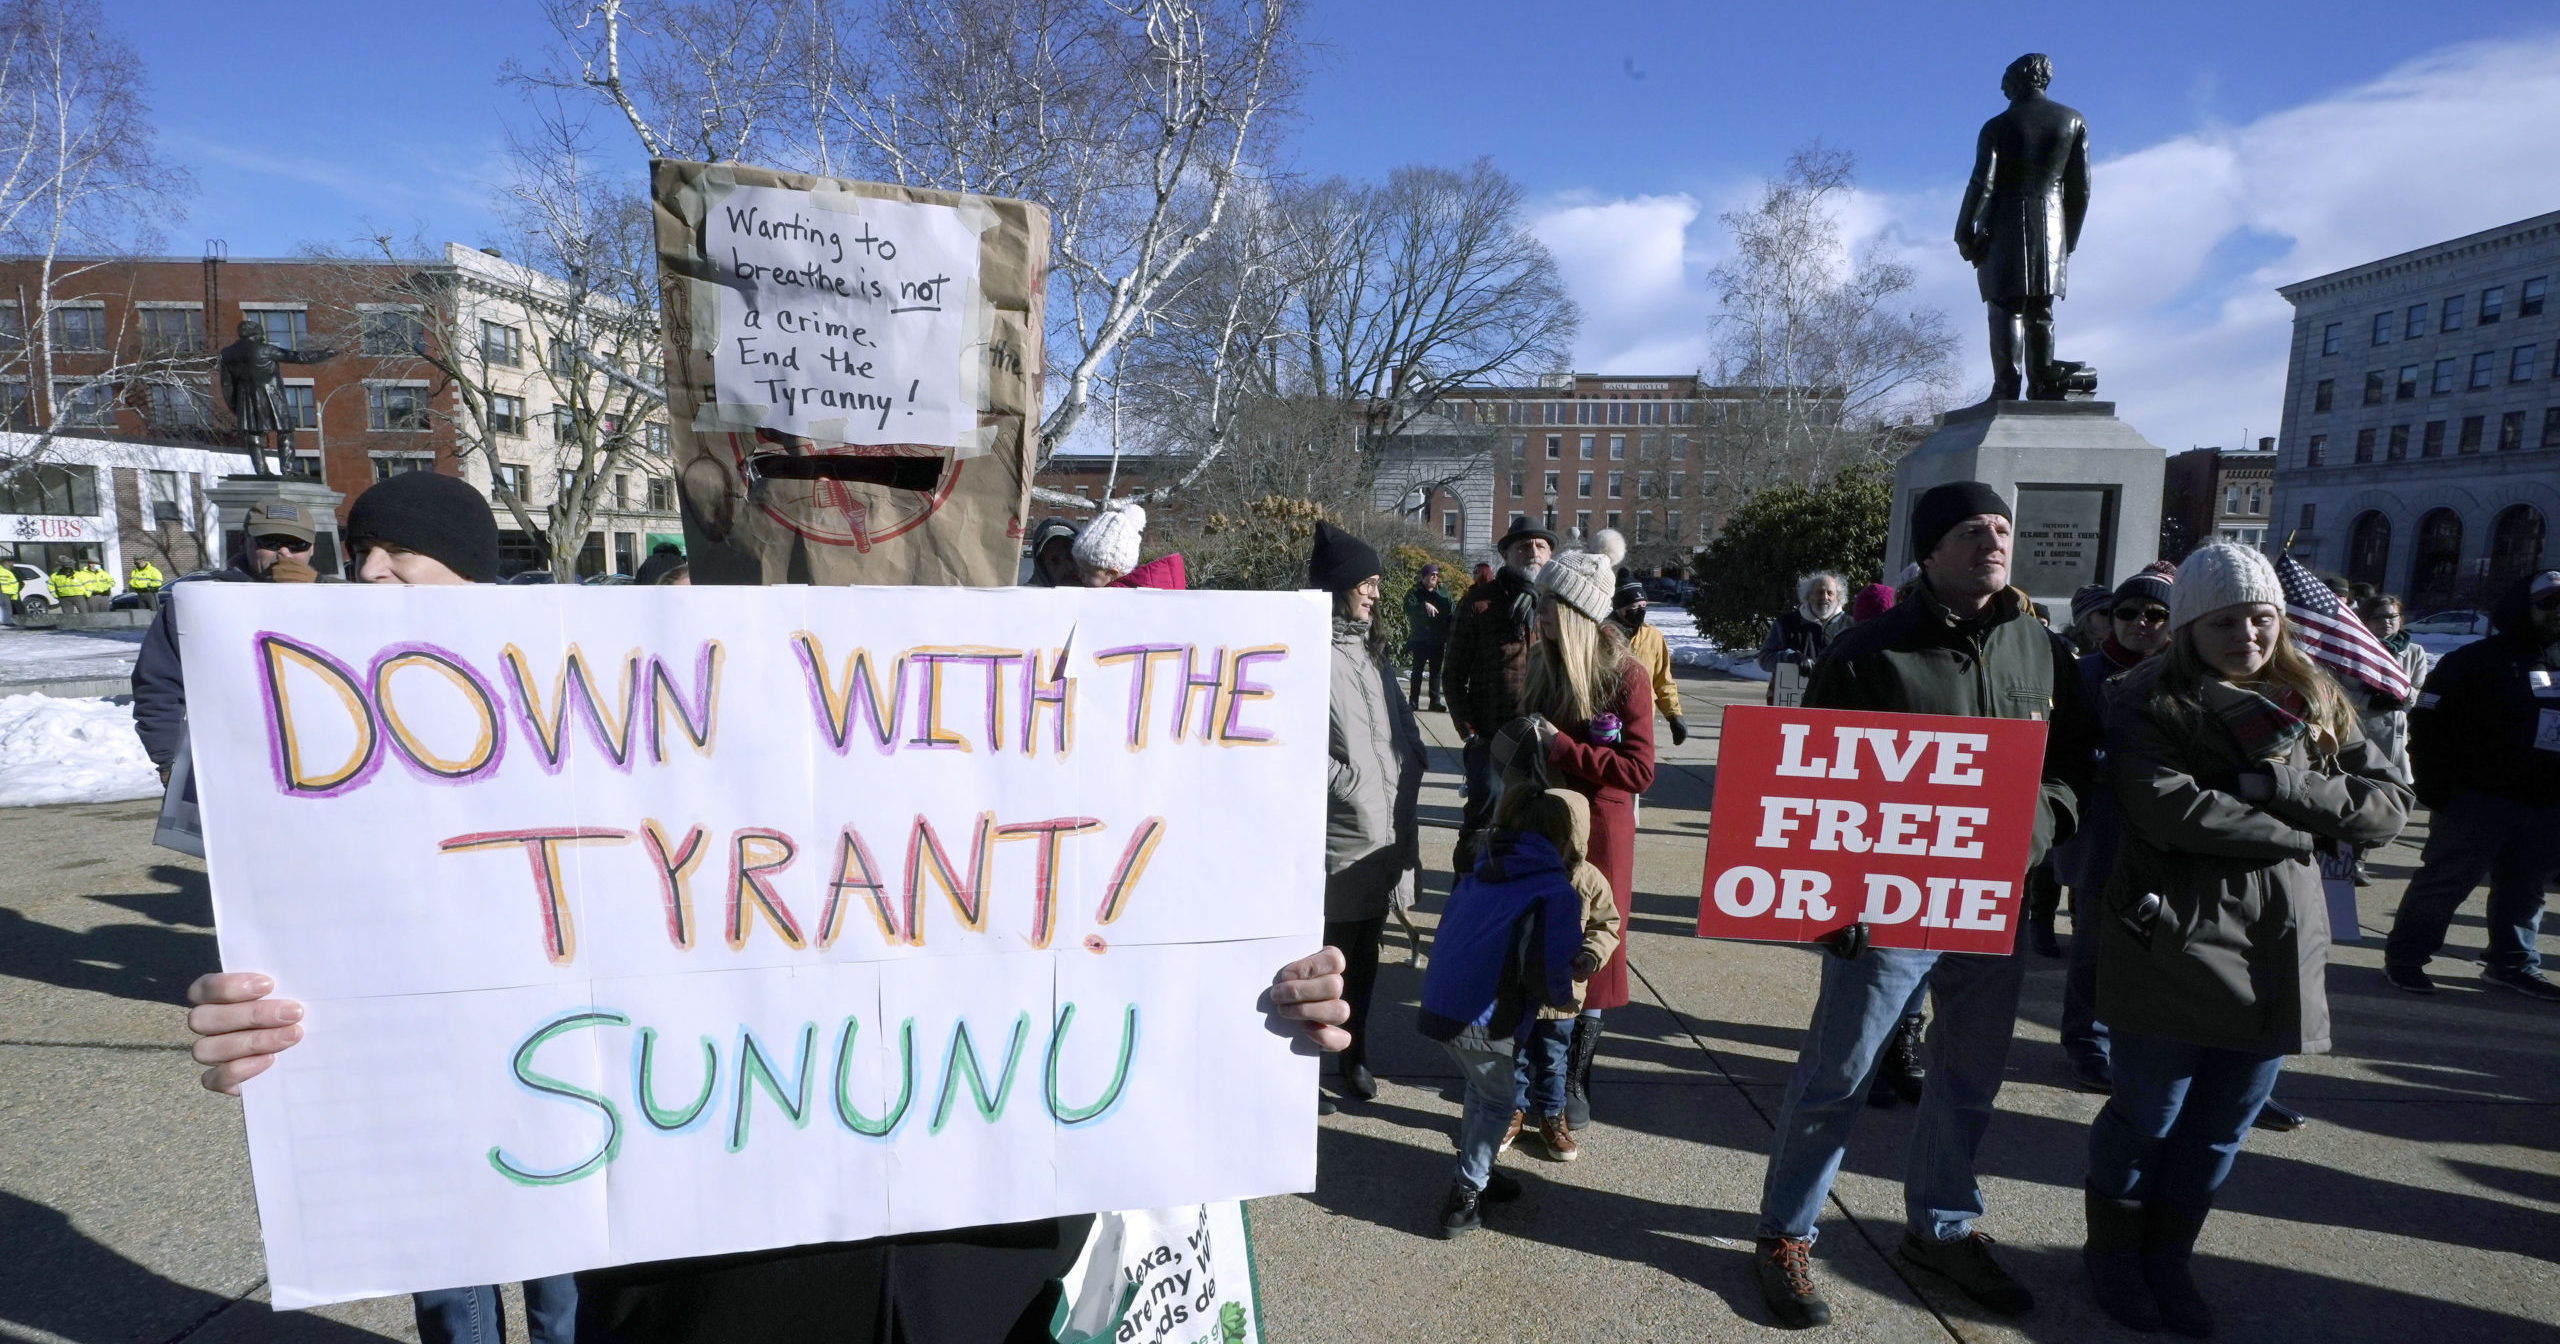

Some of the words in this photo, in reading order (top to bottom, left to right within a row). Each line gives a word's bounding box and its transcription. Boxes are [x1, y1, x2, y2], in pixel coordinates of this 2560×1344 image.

[726, 206, 842, 263] Wanting
[854, 222, 897, 260] to
[732, 247, 850, 297] breathe
[860, 268, 882, 298] is
[901, 273, 951, 302] not
[743, 310, 763, 330] a
[737, 337, 800, 371] End
[820, 346, 876, 379] the
[40, 519, 81, 537] UBS
[255, 630, 725, 797] DOWN
[790, 631, 1076, 762] WITH
[1092, 642, 1289, 752] THE
[1775, 723, 1988, 787] LIVE
[1755, 795, 1989, 859] FREE
[438, 810, 1166, 966] TYRANT!
[1713, 865, 1836, 922] OR
[1857, 872, 2012, 932] DIE
[486, 1002, 1143, 1186] SUNUNU
[1123, 1245, 1182, 1286] lexa,
[1118, 1300, 1152, 1343] are
[1150, 1268, 1192, 1305] my
